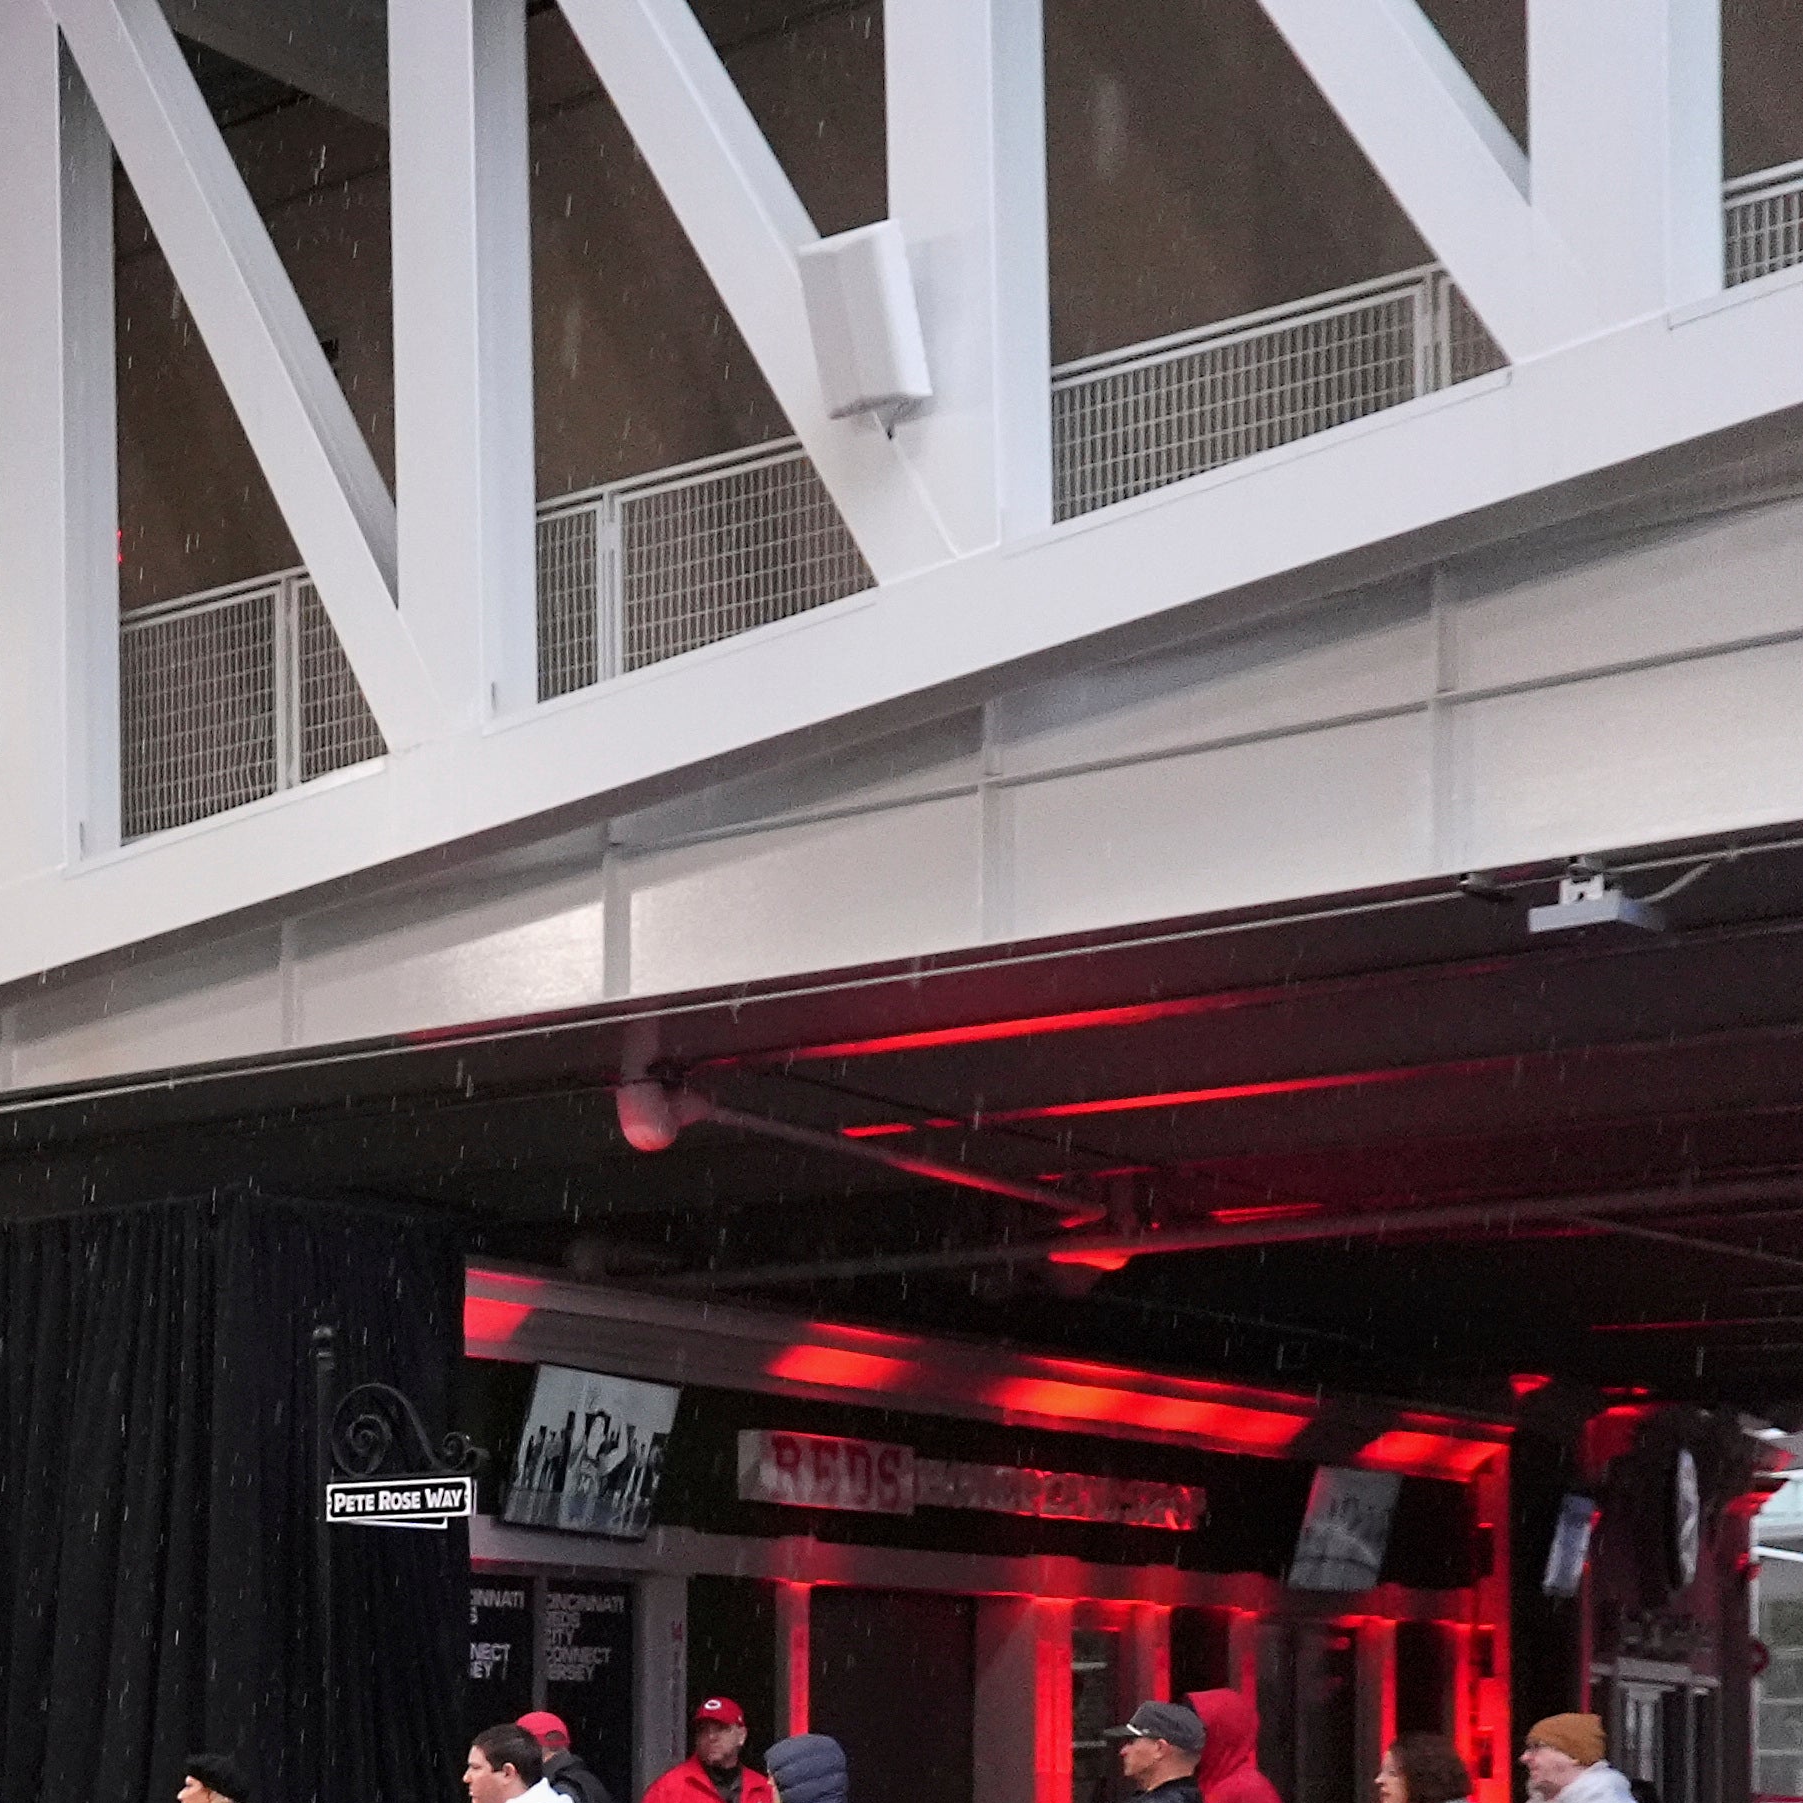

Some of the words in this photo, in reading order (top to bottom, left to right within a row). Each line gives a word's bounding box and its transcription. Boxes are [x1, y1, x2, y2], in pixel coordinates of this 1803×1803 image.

[333, 1492, 375, 1513] PETE
[378, 1490, 422, 1511] ROSE
[424, 1487, 463, 1509] WAY
